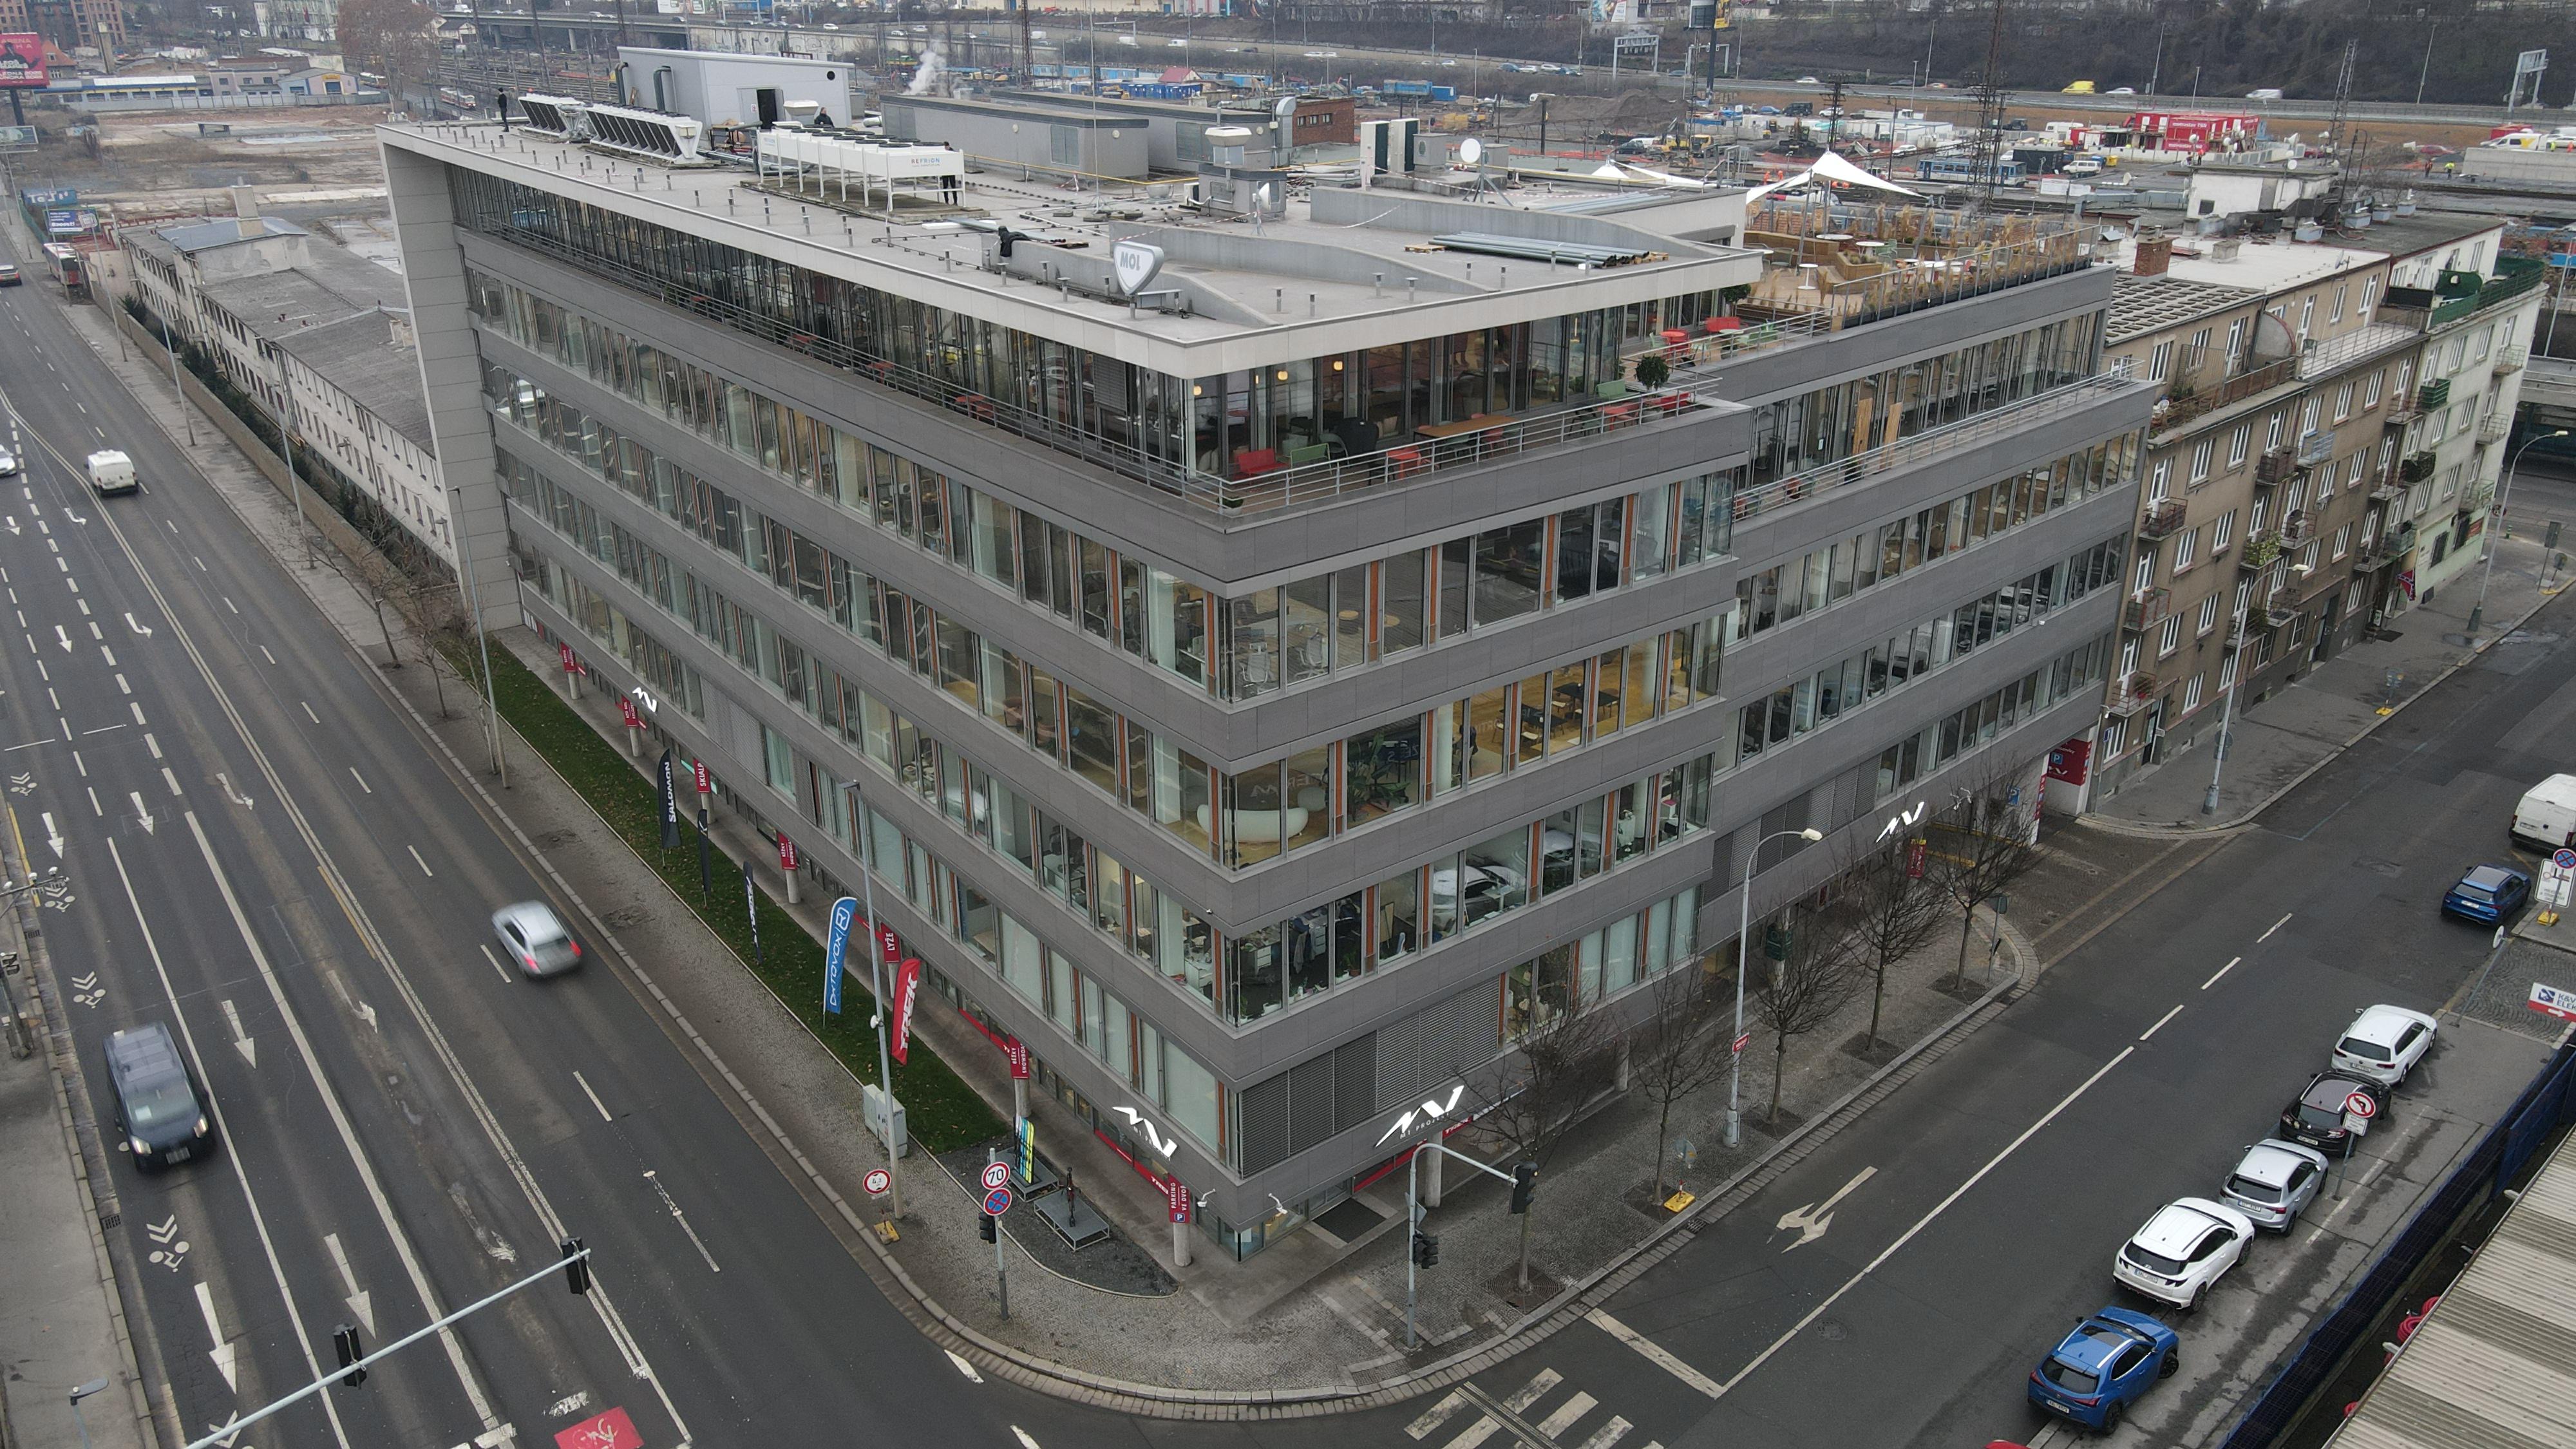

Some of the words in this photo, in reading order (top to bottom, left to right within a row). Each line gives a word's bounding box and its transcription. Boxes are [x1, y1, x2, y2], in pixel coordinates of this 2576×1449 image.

[1120, 251, 1141, 271] MOL
[2053, 753, 2060, 762] P
[697, 762, 706, 786] SKIALP
[664, 761, 676, 823] SALOMON
[886, 932, 895, 951] LYŽE
[900, 972, 918, 1050] TREK
[988, 1169, 1004, 1184] 70
